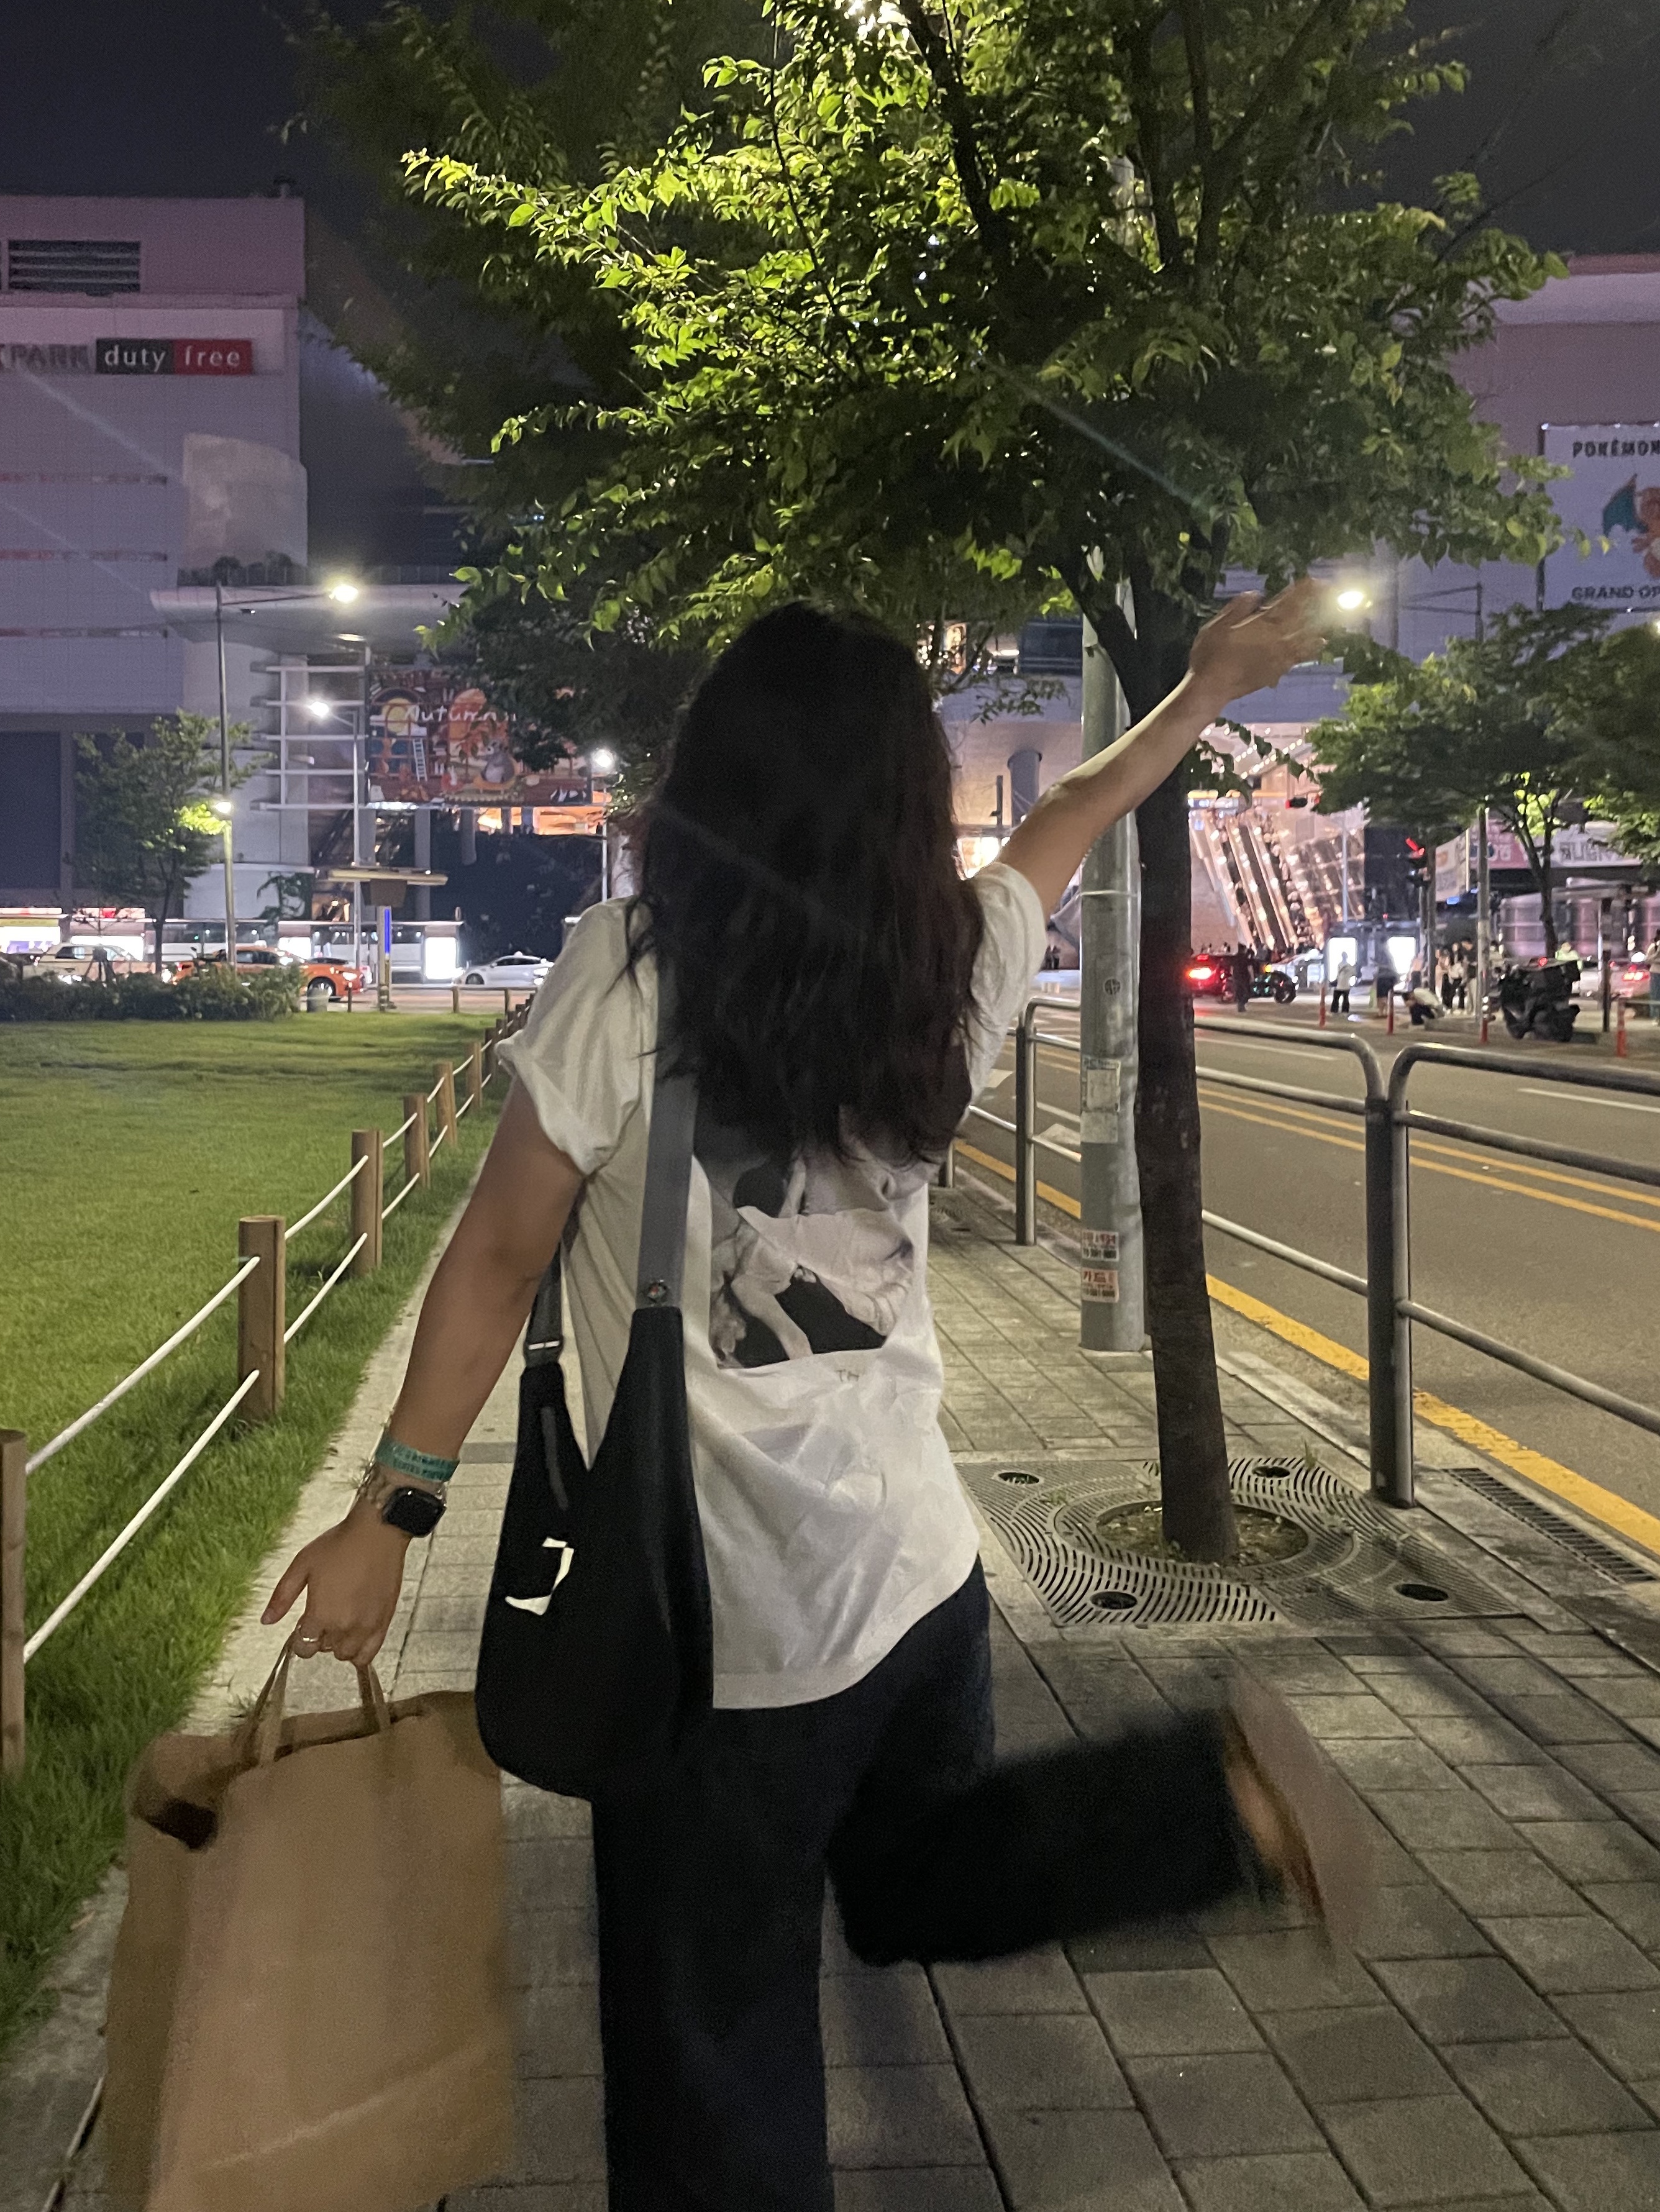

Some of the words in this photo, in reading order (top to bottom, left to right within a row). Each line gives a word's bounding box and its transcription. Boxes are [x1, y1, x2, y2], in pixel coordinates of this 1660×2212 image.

[104, 344, 166, 371] duty
[185, 345, 241, 367] free
[1571, 586, 1634, 600] GRAND
